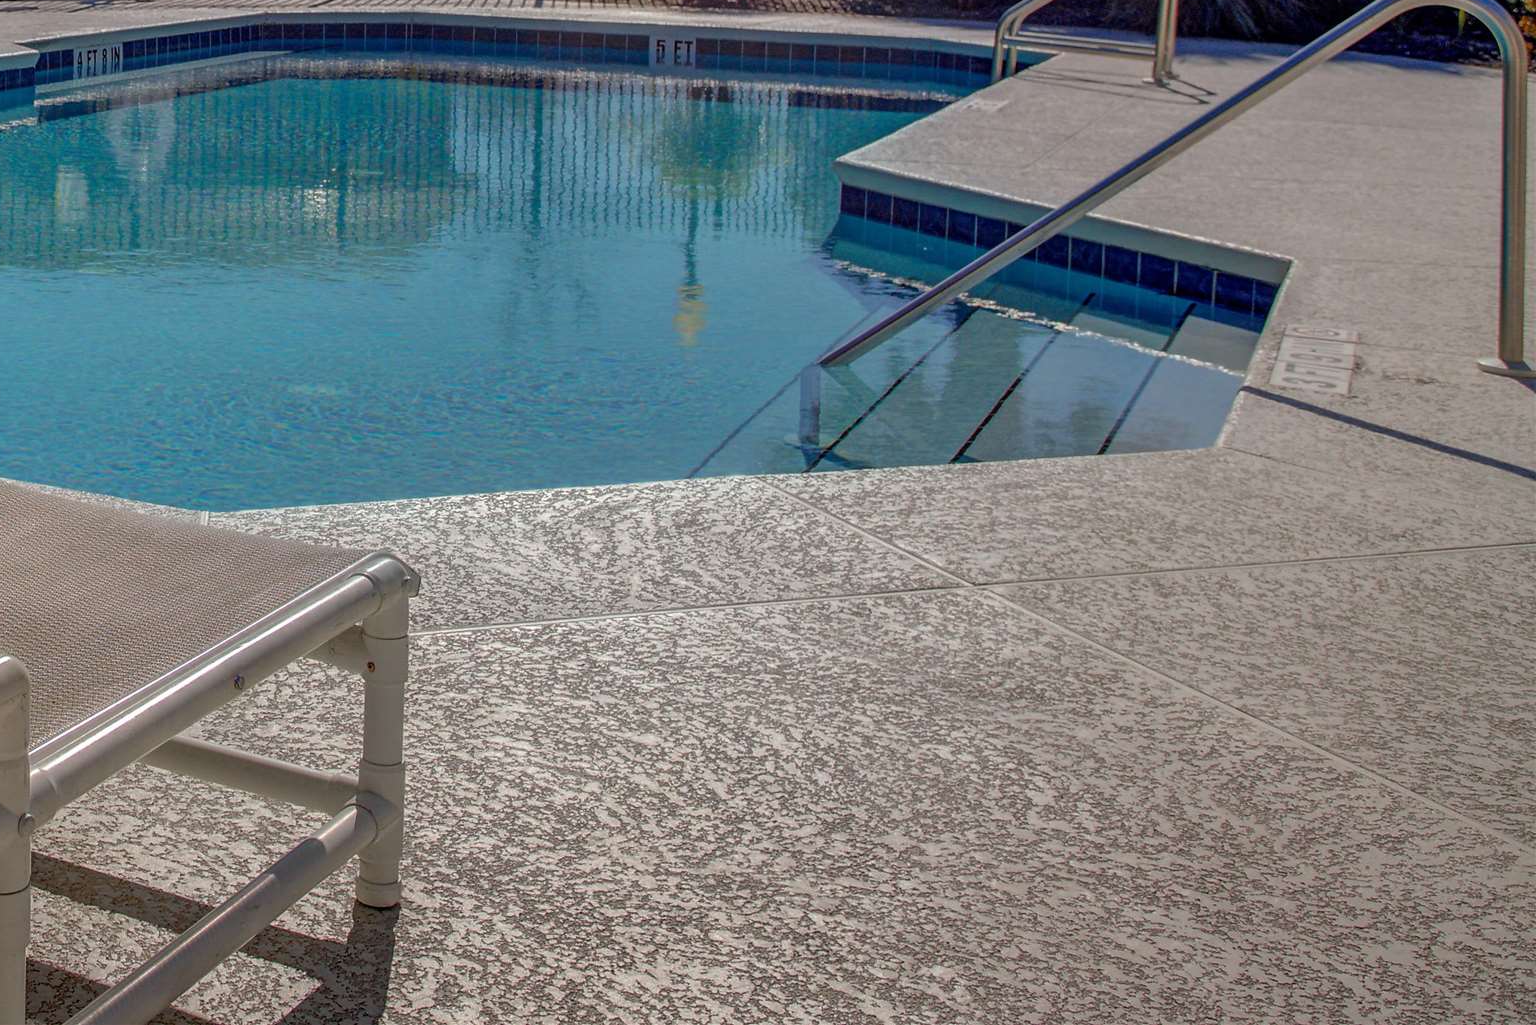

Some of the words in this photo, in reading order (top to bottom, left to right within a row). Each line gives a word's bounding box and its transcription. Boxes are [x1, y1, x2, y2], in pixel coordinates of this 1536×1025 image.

[77, 51, 82, 64] 4
[87, 50, 97, 64] FT
[111, 46, 120, 61] IN
[674, 39, 693, 55] FT
